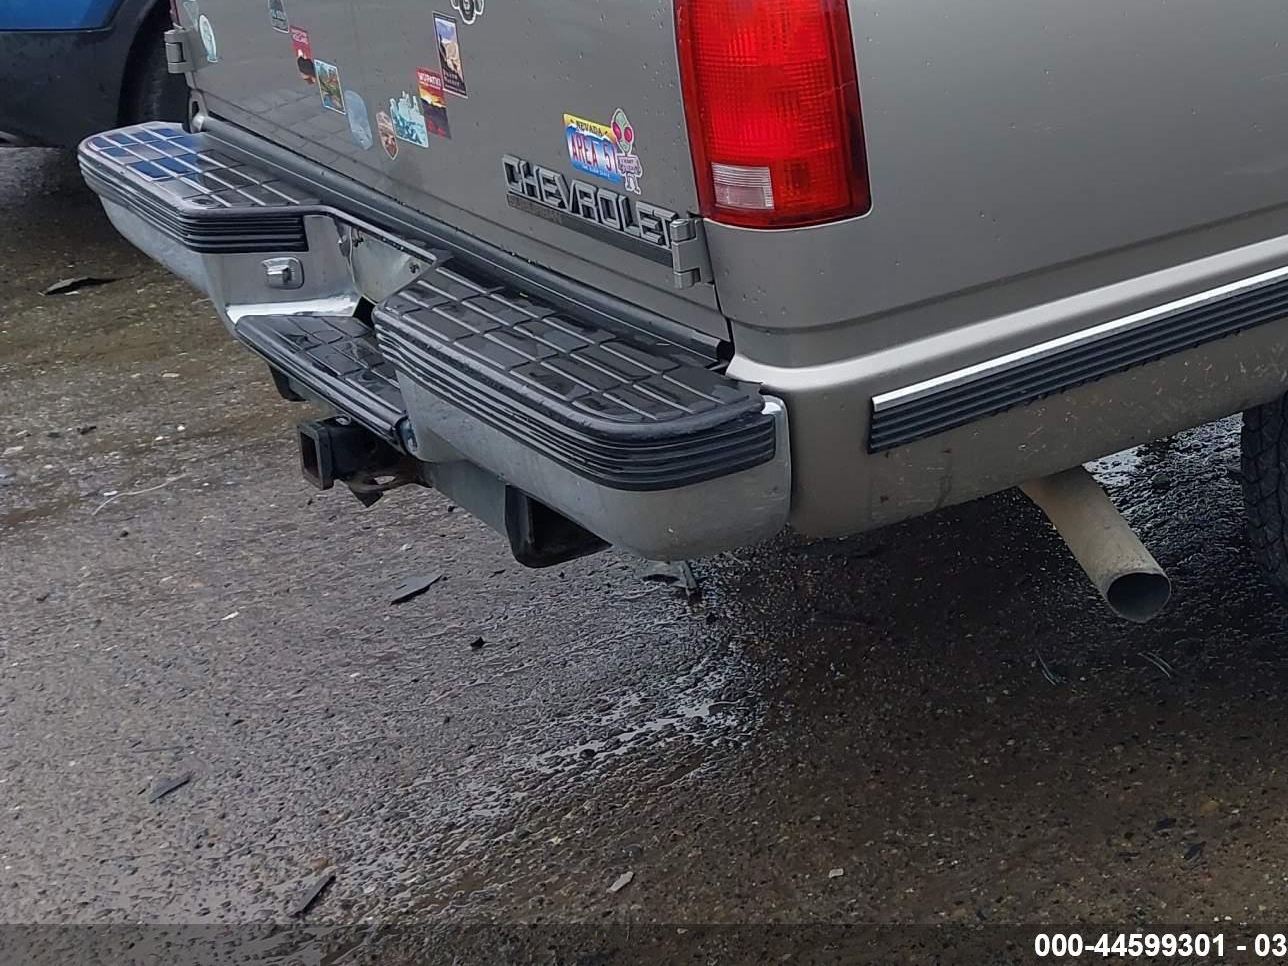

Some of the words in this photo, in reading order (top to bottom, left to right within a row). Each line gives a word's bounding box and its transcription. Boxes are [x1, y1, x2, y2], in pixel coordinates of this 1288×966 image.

[575, 120, 603, 136] NEVADA
[571, 134, 599, 167] AREA
[502, 154, 680, 249] CHEVROLET
